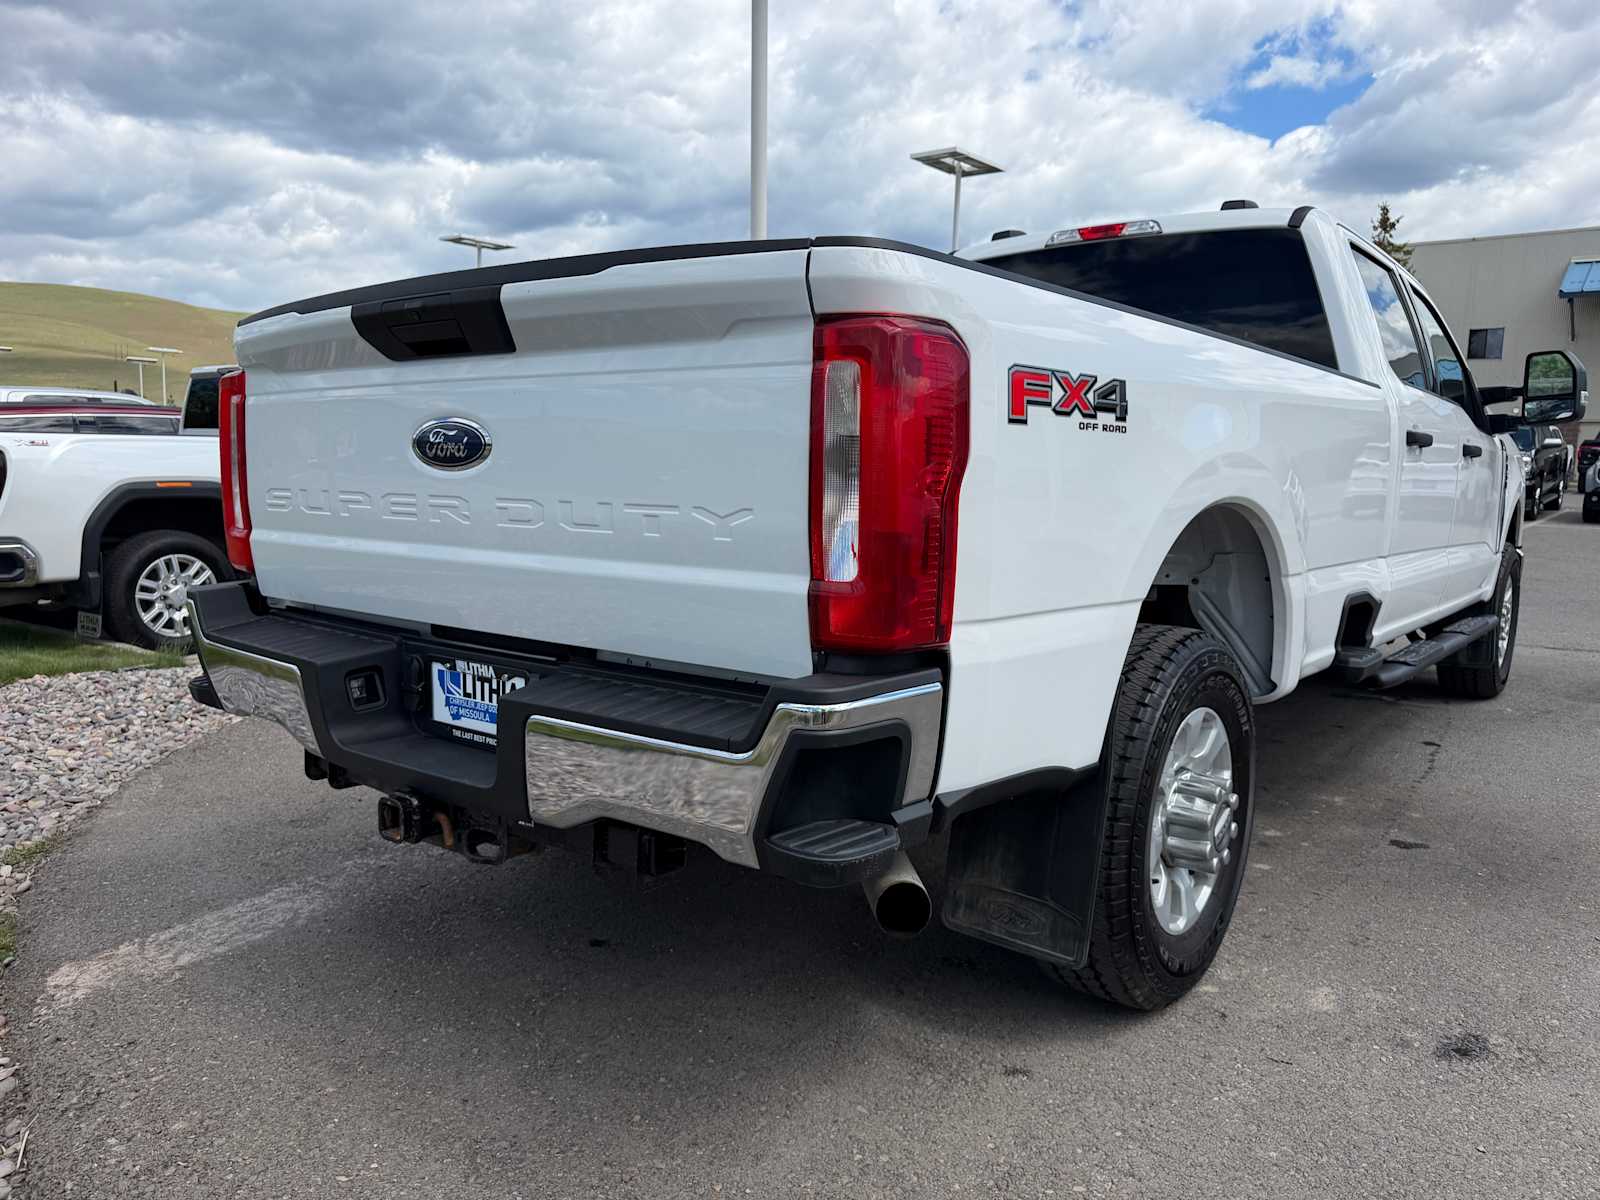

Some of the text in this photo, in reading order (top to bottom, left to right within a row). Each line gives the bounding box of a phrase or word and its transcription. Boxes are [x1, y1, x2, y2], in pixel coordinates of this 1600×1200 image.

[1008, 363, 1128, 424] FX4
[1078, 422, 1127, 434] OFF ROAD
[426, 428, 468, 458] Ford
[265, 487, 754, 541] SUPER DUTY
[449, 697, 476, 709] CHRYSLER
[449, 705, 490, 722] OF MISSOULA
[452, 729, 462, 738] THE
[462, 731, 473, 741] LAST
[474, 734, 485, 743] BEST
